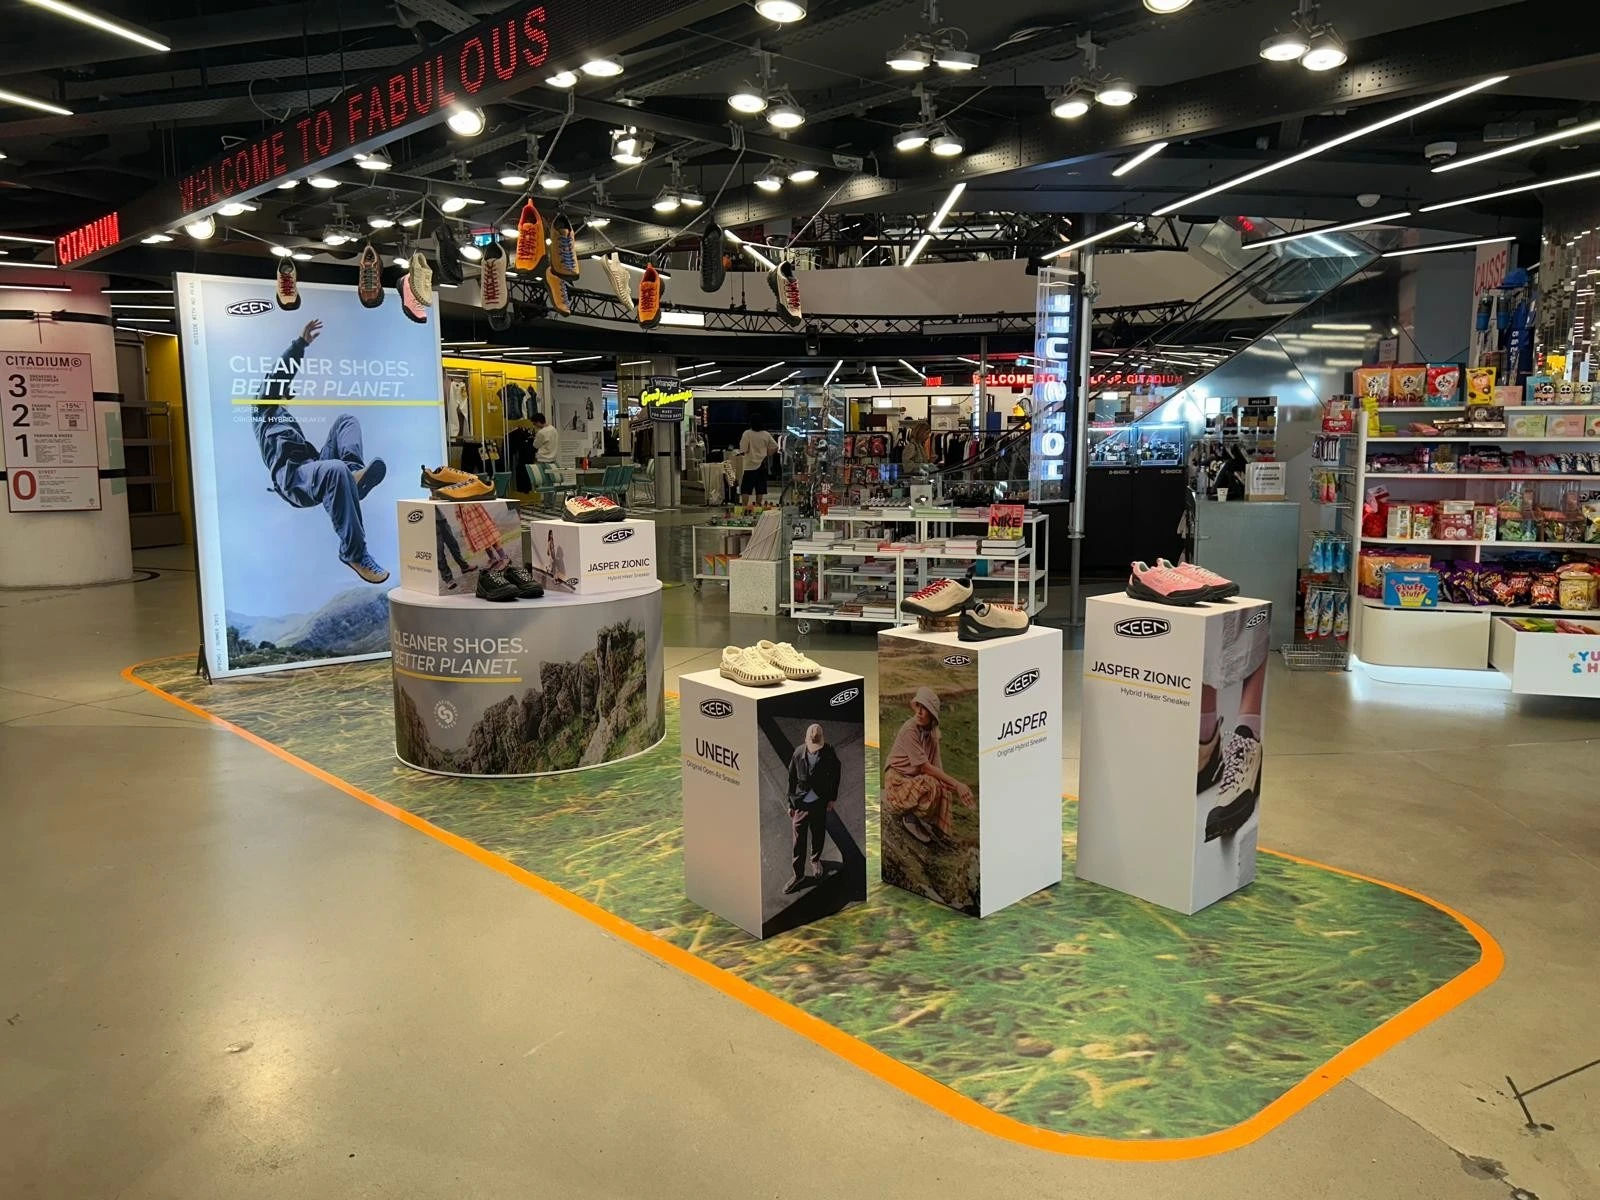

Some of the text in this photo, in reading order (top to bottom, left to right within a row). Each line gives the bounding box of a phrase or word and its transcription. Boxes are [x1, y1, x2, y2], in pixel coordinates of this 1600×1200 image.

[180, 6, 550, 213] WELCOME TO FABULOUS
[58, 212, 120, 265] CITADIUM
[1474, 250, 1506, 296] CAISSE
[227, 301, 273, 314] KEEN
[229, 355, 415, 377] CLEANER SHOES.
[8, 374, 27, 398] 3
[231, 378, 406, 398] BETTER PLANET.
[641, 387, 660, 406] Good
[11, 404, 30, 427] 2
[15, 434, 29, 457] 1
[12, 470, 37, 501] 0
[603, 529, 633, 542] KEEN
[415, 551, 432, 560] JASPER
[588, 558, 650, 572] JASPER ZIONIC
[1116, 620, 1168, 636] KEEN
[1246, 610, 1267, 628] KEEN
[394, 630, 529, 654] CLEANER SHOES.
[395, 649, 518, 675] BETTER PLANET.
[943, 656, 970, 665] KEEN
[1572, 663, 1582, 673] &
[1005, 671, 1039, 695] KEEN
[1091, 661, 1192, 689] JASPER ZIONIC
[831, 688, 858, 705] KEEN
[1120, 687, 1190, 707] Hybrid Hiker Sneaker
[701, 702, 732, 716] KEEN
[997, 710, 1048, 740] JASPER
[695, 737, 740, 770] UNEEK
[997, 745, 1014, 757] Original
